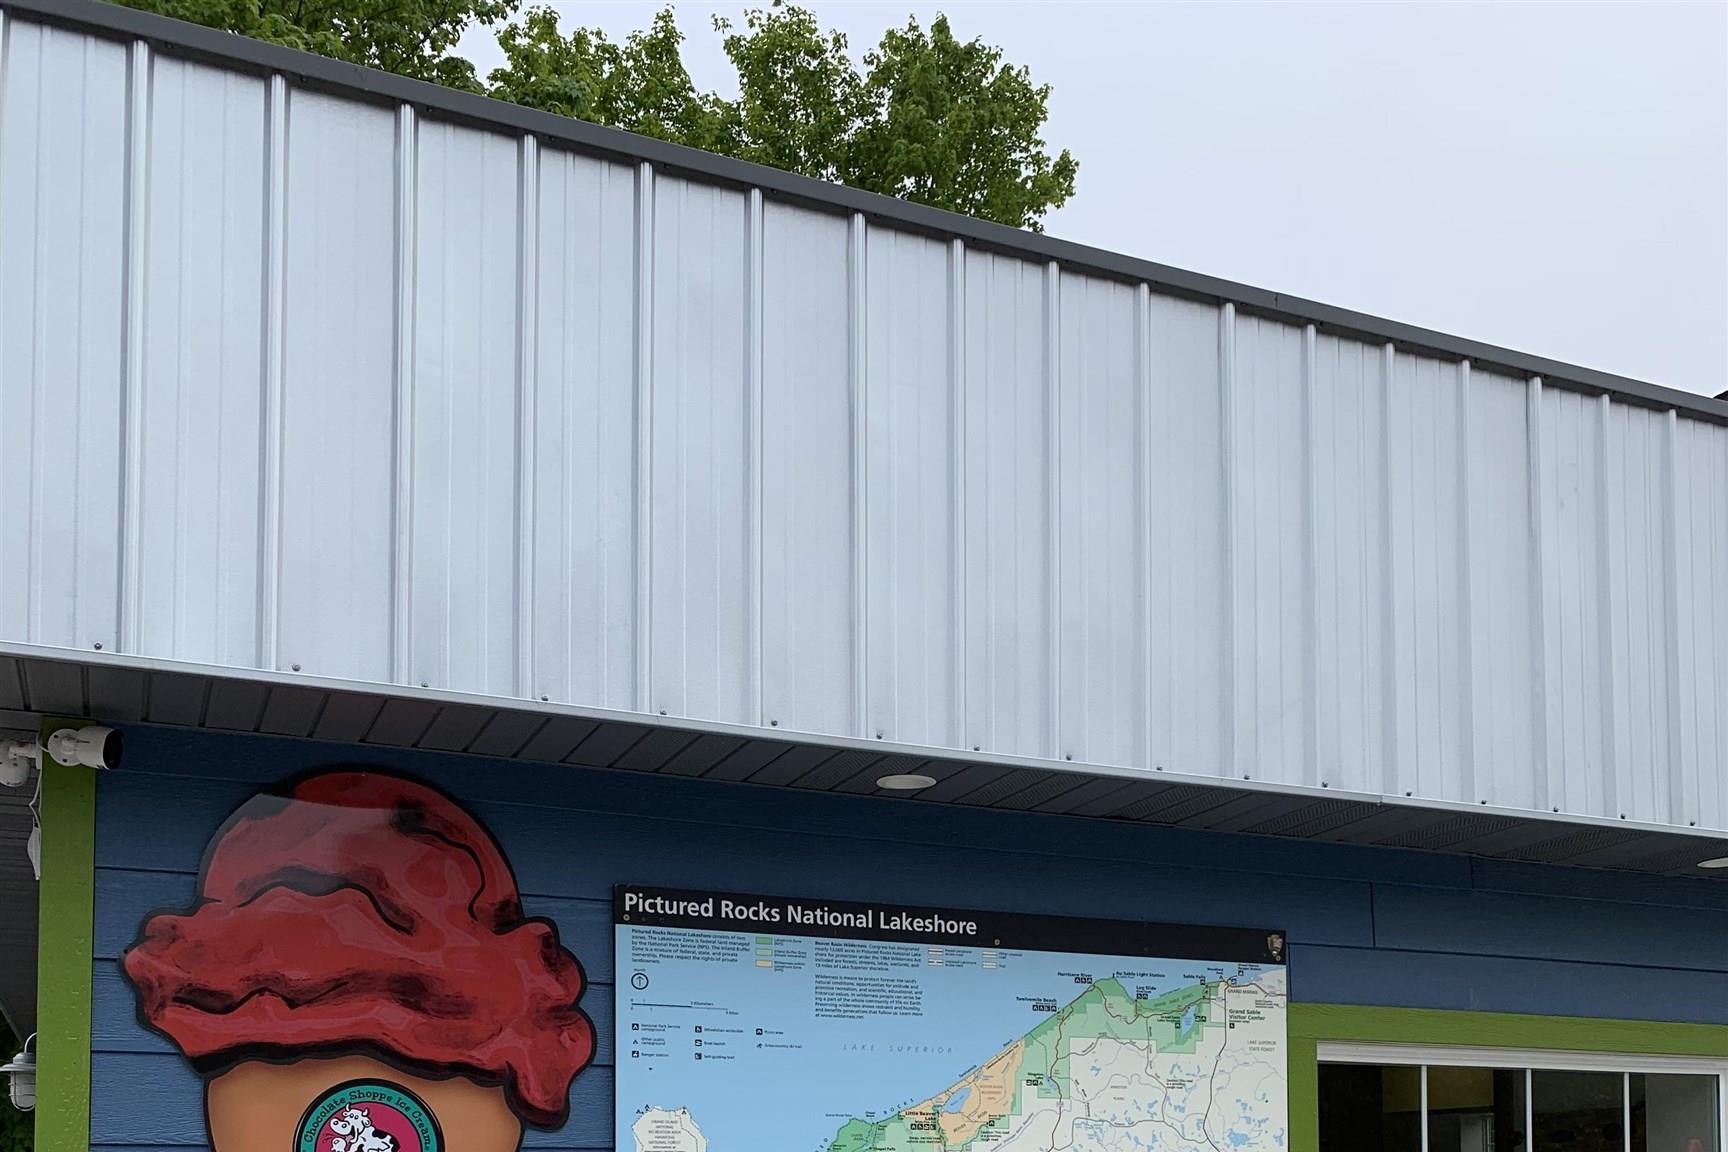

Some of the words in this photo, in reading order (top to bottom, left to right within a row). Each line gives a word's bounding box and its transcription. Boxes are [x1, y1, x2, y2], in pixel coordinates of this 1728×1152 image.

[624, 892, 714, 918] Pictured
[721, 900, 780, 922] Rocks
[787, 904, 873, 930] National
[879, 909, 977, 936] Lakeshore
[889, 1045, 952, 1053] SUPERIOR
[304, 1096, 346, 1143] Chocolate
[349, 1090, 393, 1102] Shoppe
[396, 1095, 412, 1113] Ice
[412, 1110, 432, 1146] Cream
